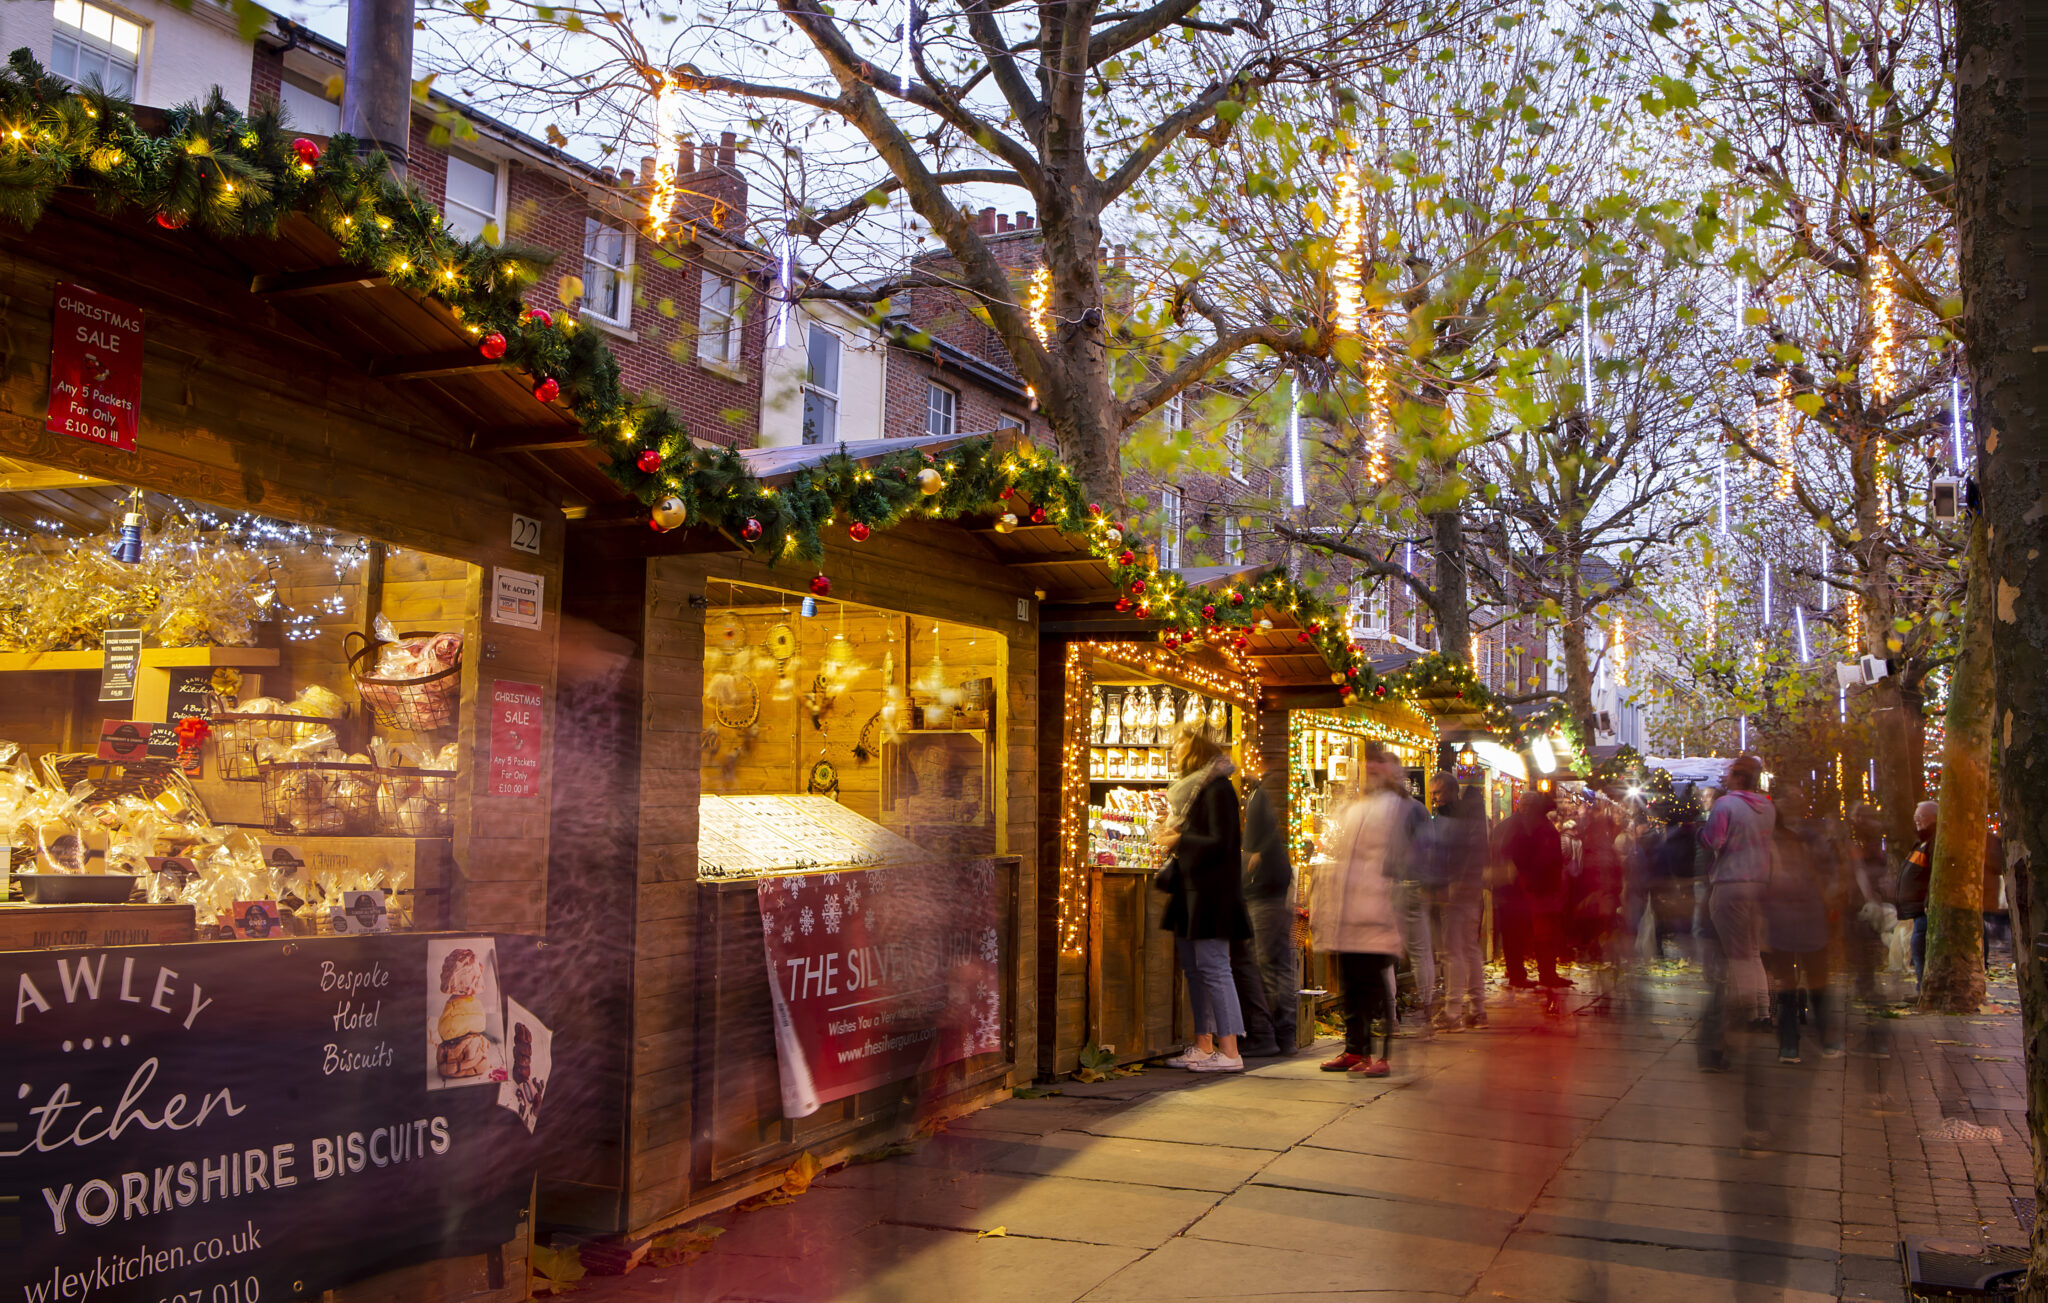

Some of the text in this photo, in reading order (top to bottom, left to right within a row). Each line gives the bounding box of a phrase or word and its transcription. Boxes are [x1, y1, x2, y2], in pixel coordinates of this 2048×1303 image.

[58, 297, 140, 332] CHRISTMAS
[76, 327, 120, 353] SALE
[57, 381, 132, 410] Any 5 Packets
[70, 401, 116, 426] For Only
[65, 419, 106, 439] £10.00
[513, 517, 539, 551] 22
[501, 581, 536, 596] WE ACCEPT
[1018, 600, 1027, 619] 21
[494, 691, 541, 706] CHRISTMAS
[504, 711, 530, 725] SALE
[494, 756, 536, 768] Any 5 Packets
[499, 783, 522, 793] £10.00
[501, 770, 528, 782] For Only
[321, 960, 389, 997] Bespoke
[786, 952, 839, 1001] THE
[847, 942, 917, 992] SILVER
[333, 1000, 380, 1032] Hotel
[828, 1019, 857, 1036] Wishes
[857, 1015, 873, 1030] You
[873, 1016, 880, 1026] a
[880, 1010, 897, 1024] Very
[323, 1041, 394, 1075] Biscuits
[41, 1115, 451, 1236] YORKSHIRE BISCUITS
